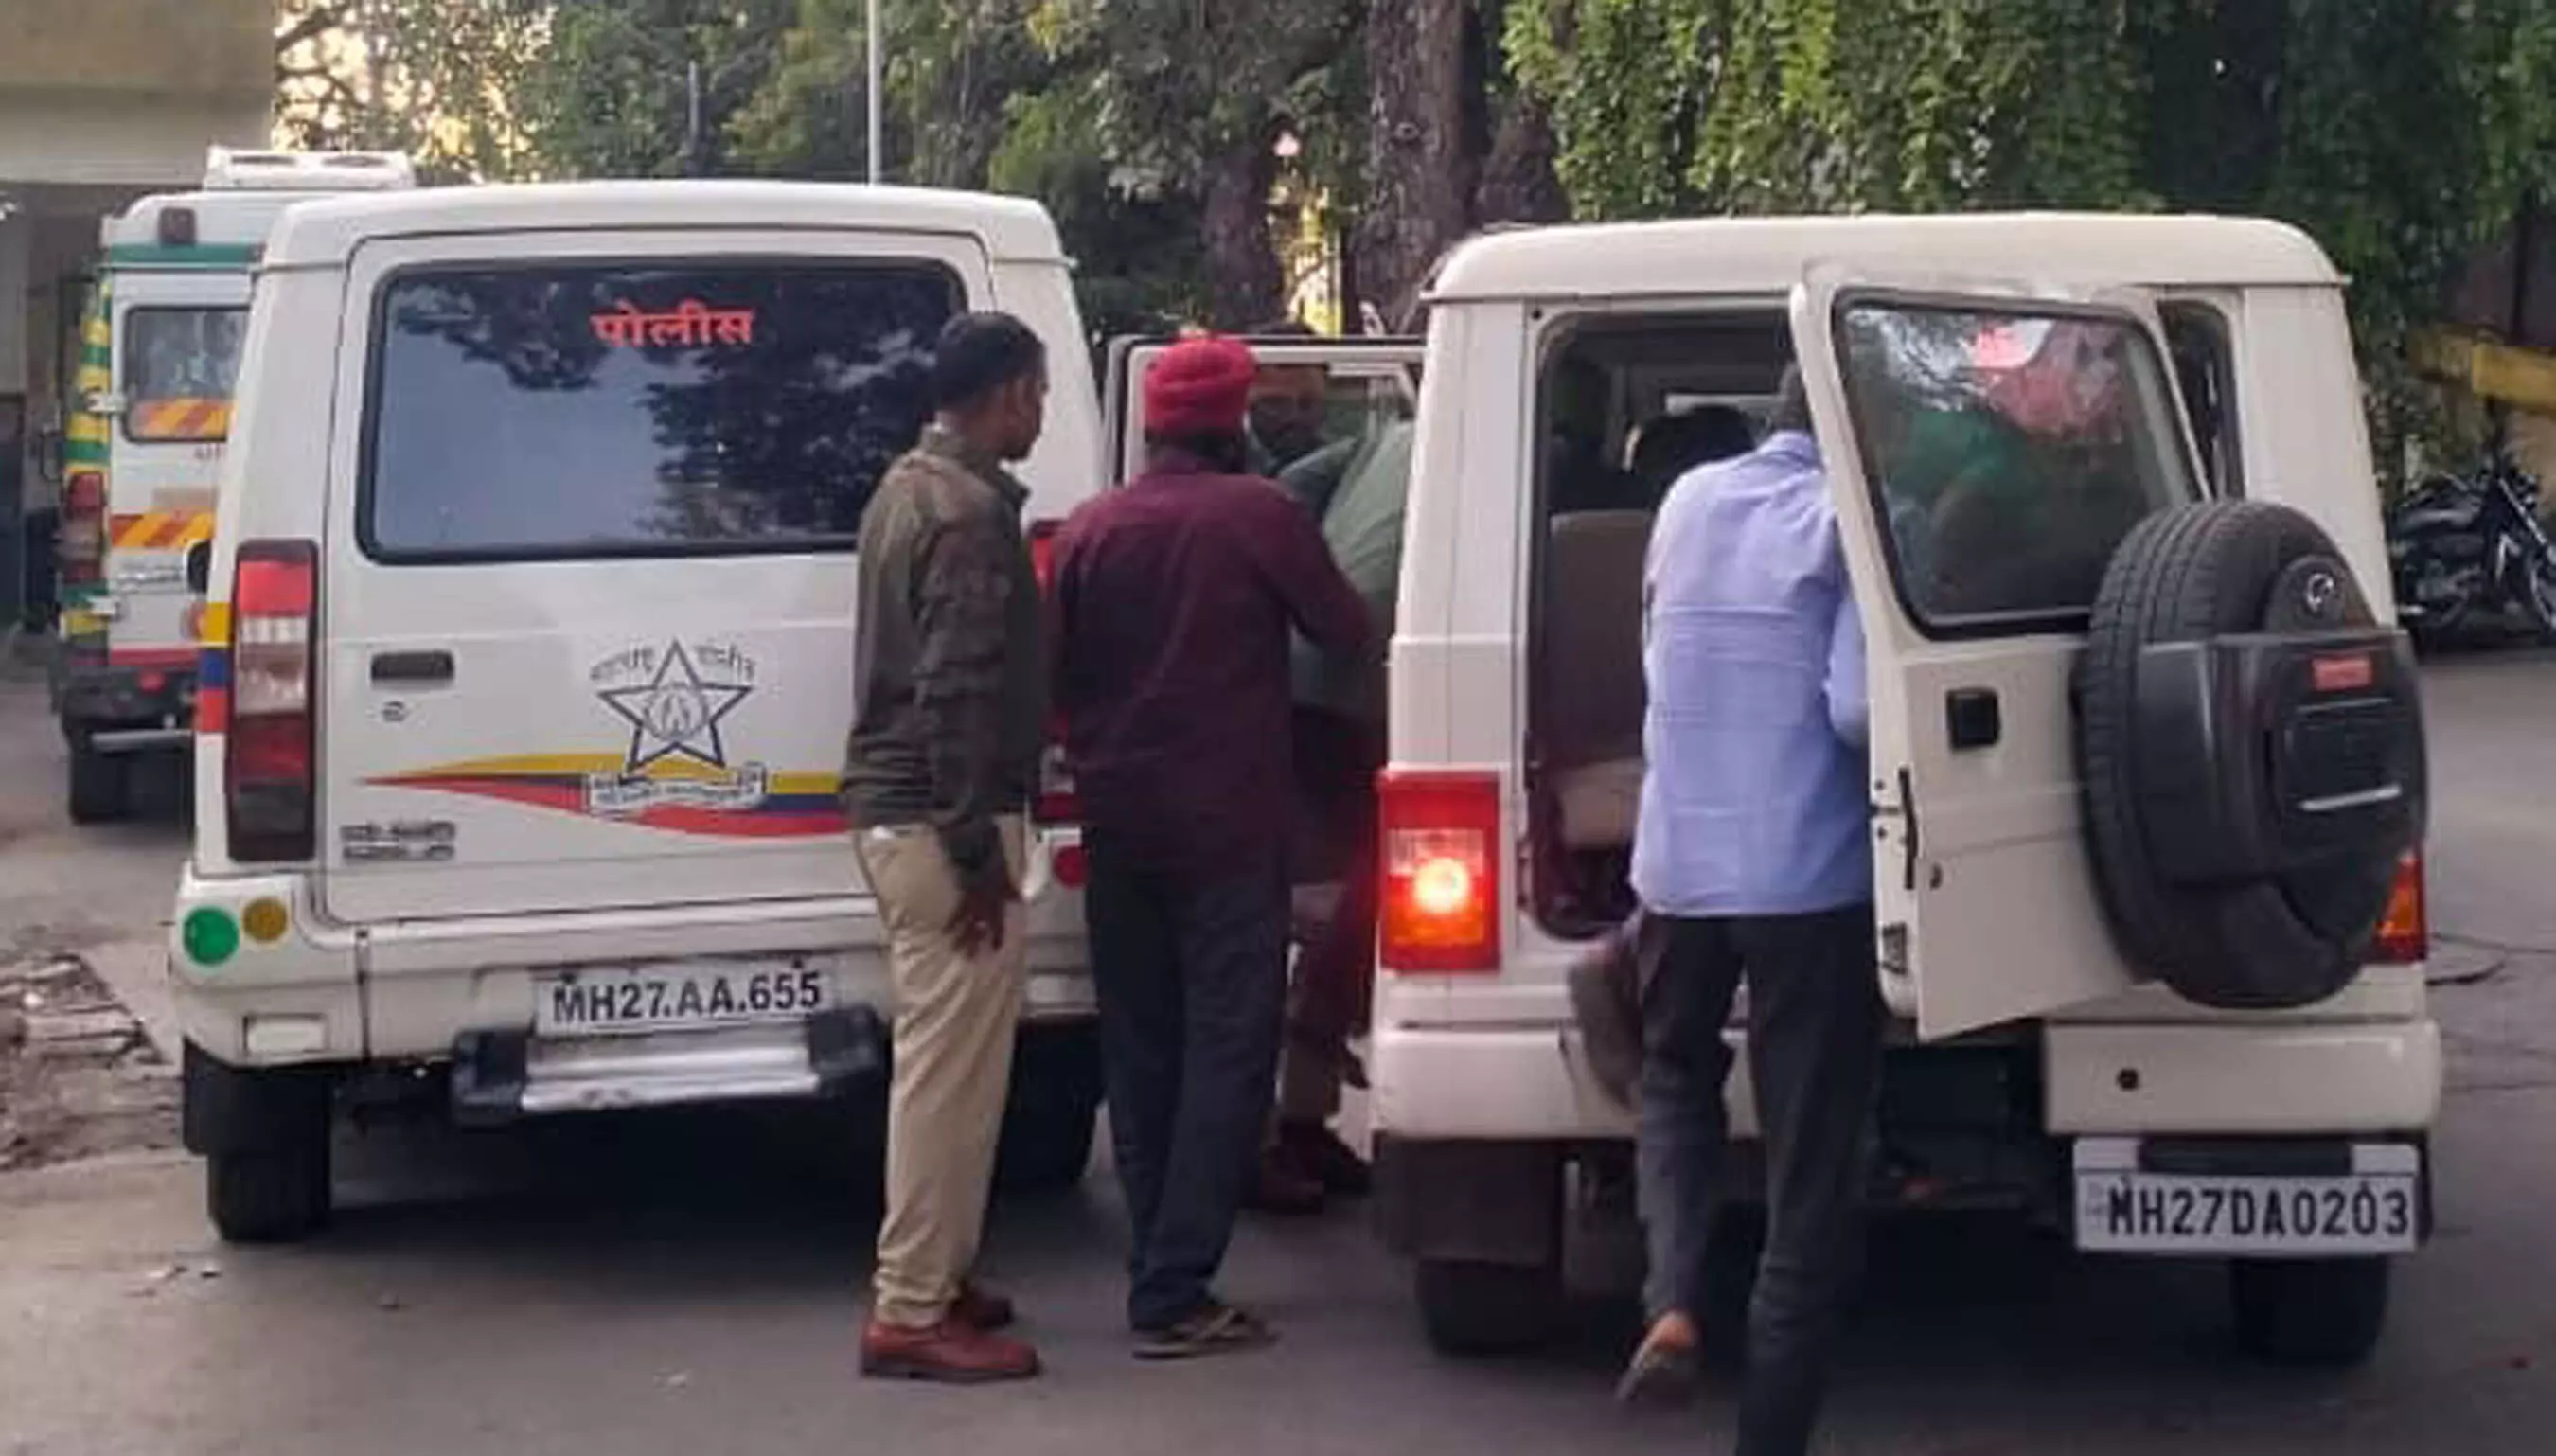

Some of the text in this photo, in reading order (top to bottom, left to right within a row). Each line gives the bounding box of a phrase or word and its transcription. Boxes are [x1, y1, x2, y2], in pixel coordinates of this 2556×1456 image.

[589, 298, 756, 347] पोलीस
[553, 970, 822, 1022] MH27.AA.655
[2107, 1187, 2410, 1236] MH27DA0203
